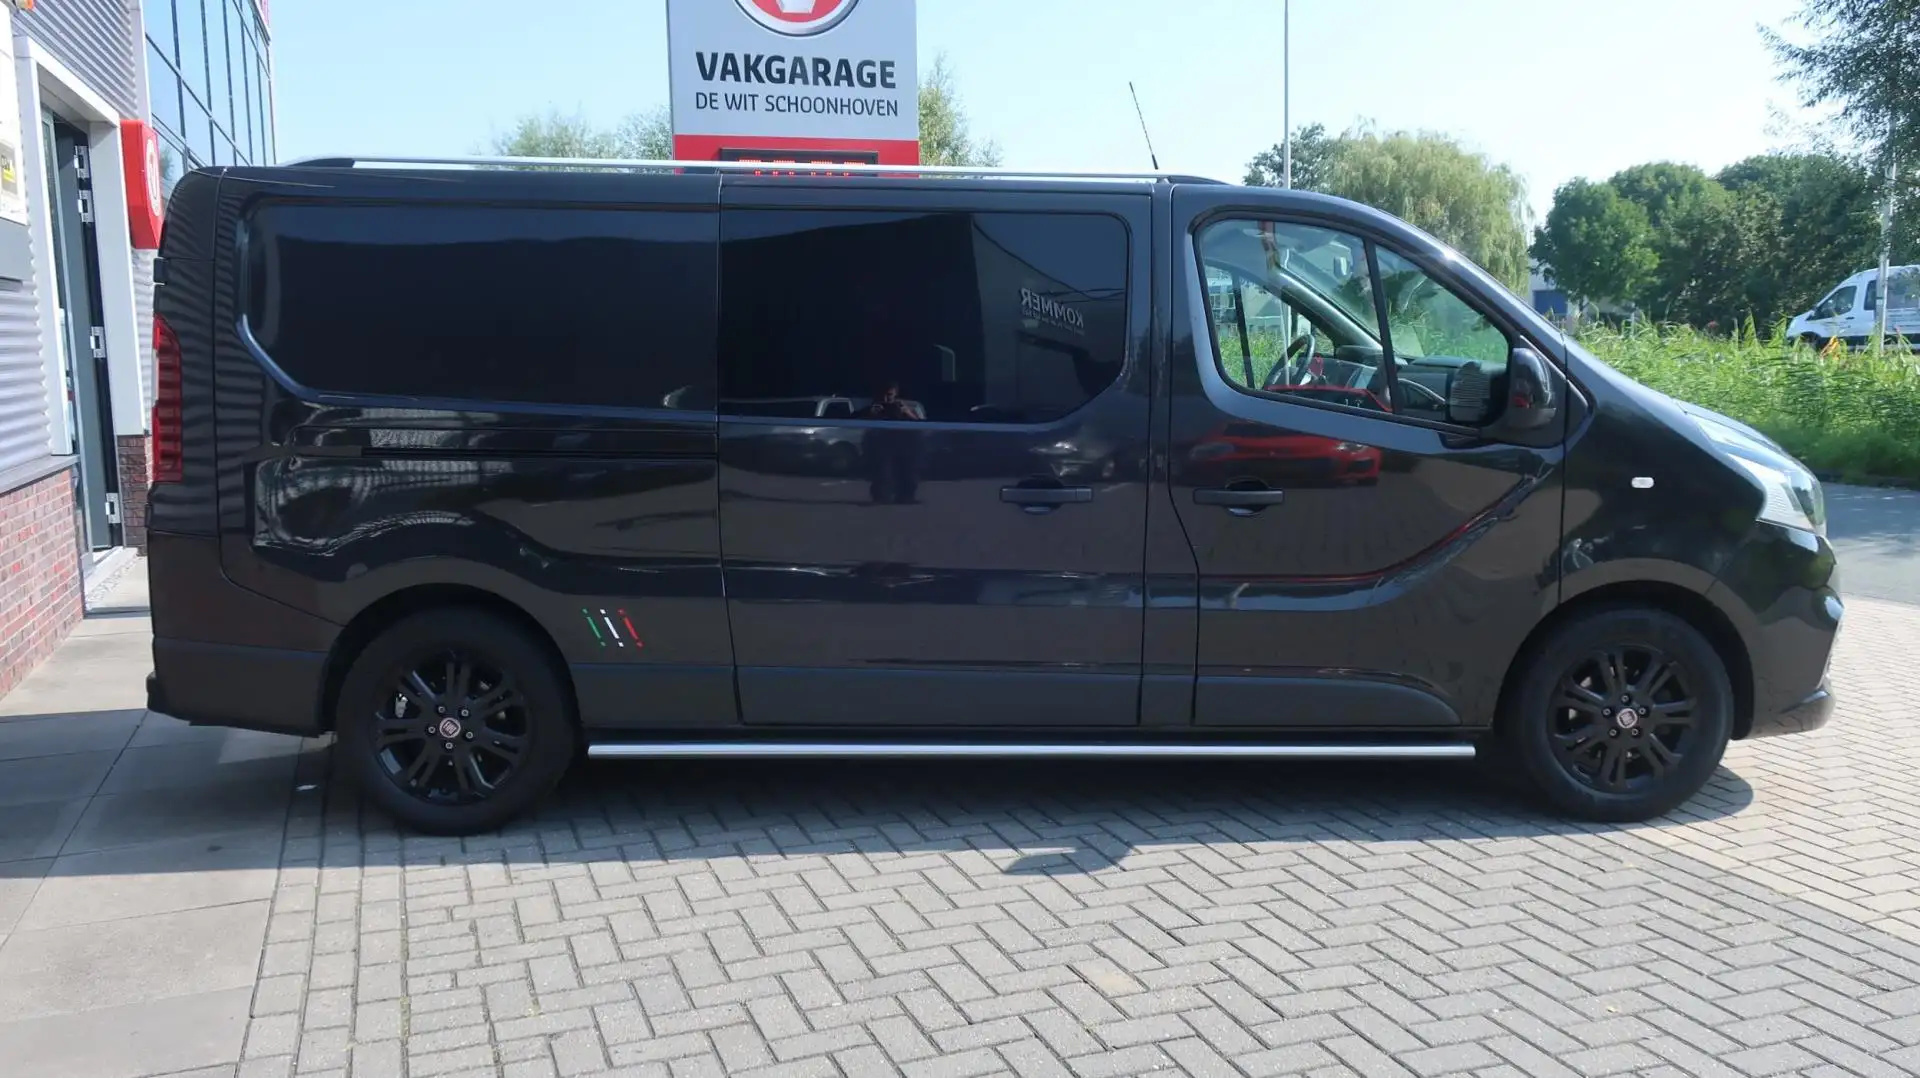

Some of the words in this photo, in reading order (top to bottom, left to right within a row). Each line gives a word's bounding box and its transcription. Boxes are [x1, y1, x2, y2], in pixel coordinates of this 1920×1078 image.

[695, 52, 896, 89] VAKGARAGE
[696, 92, 719, 110] DE
[724, 93, 759, 111] WIT
[765, 95, 898, 117] SCHOONHOVEN
